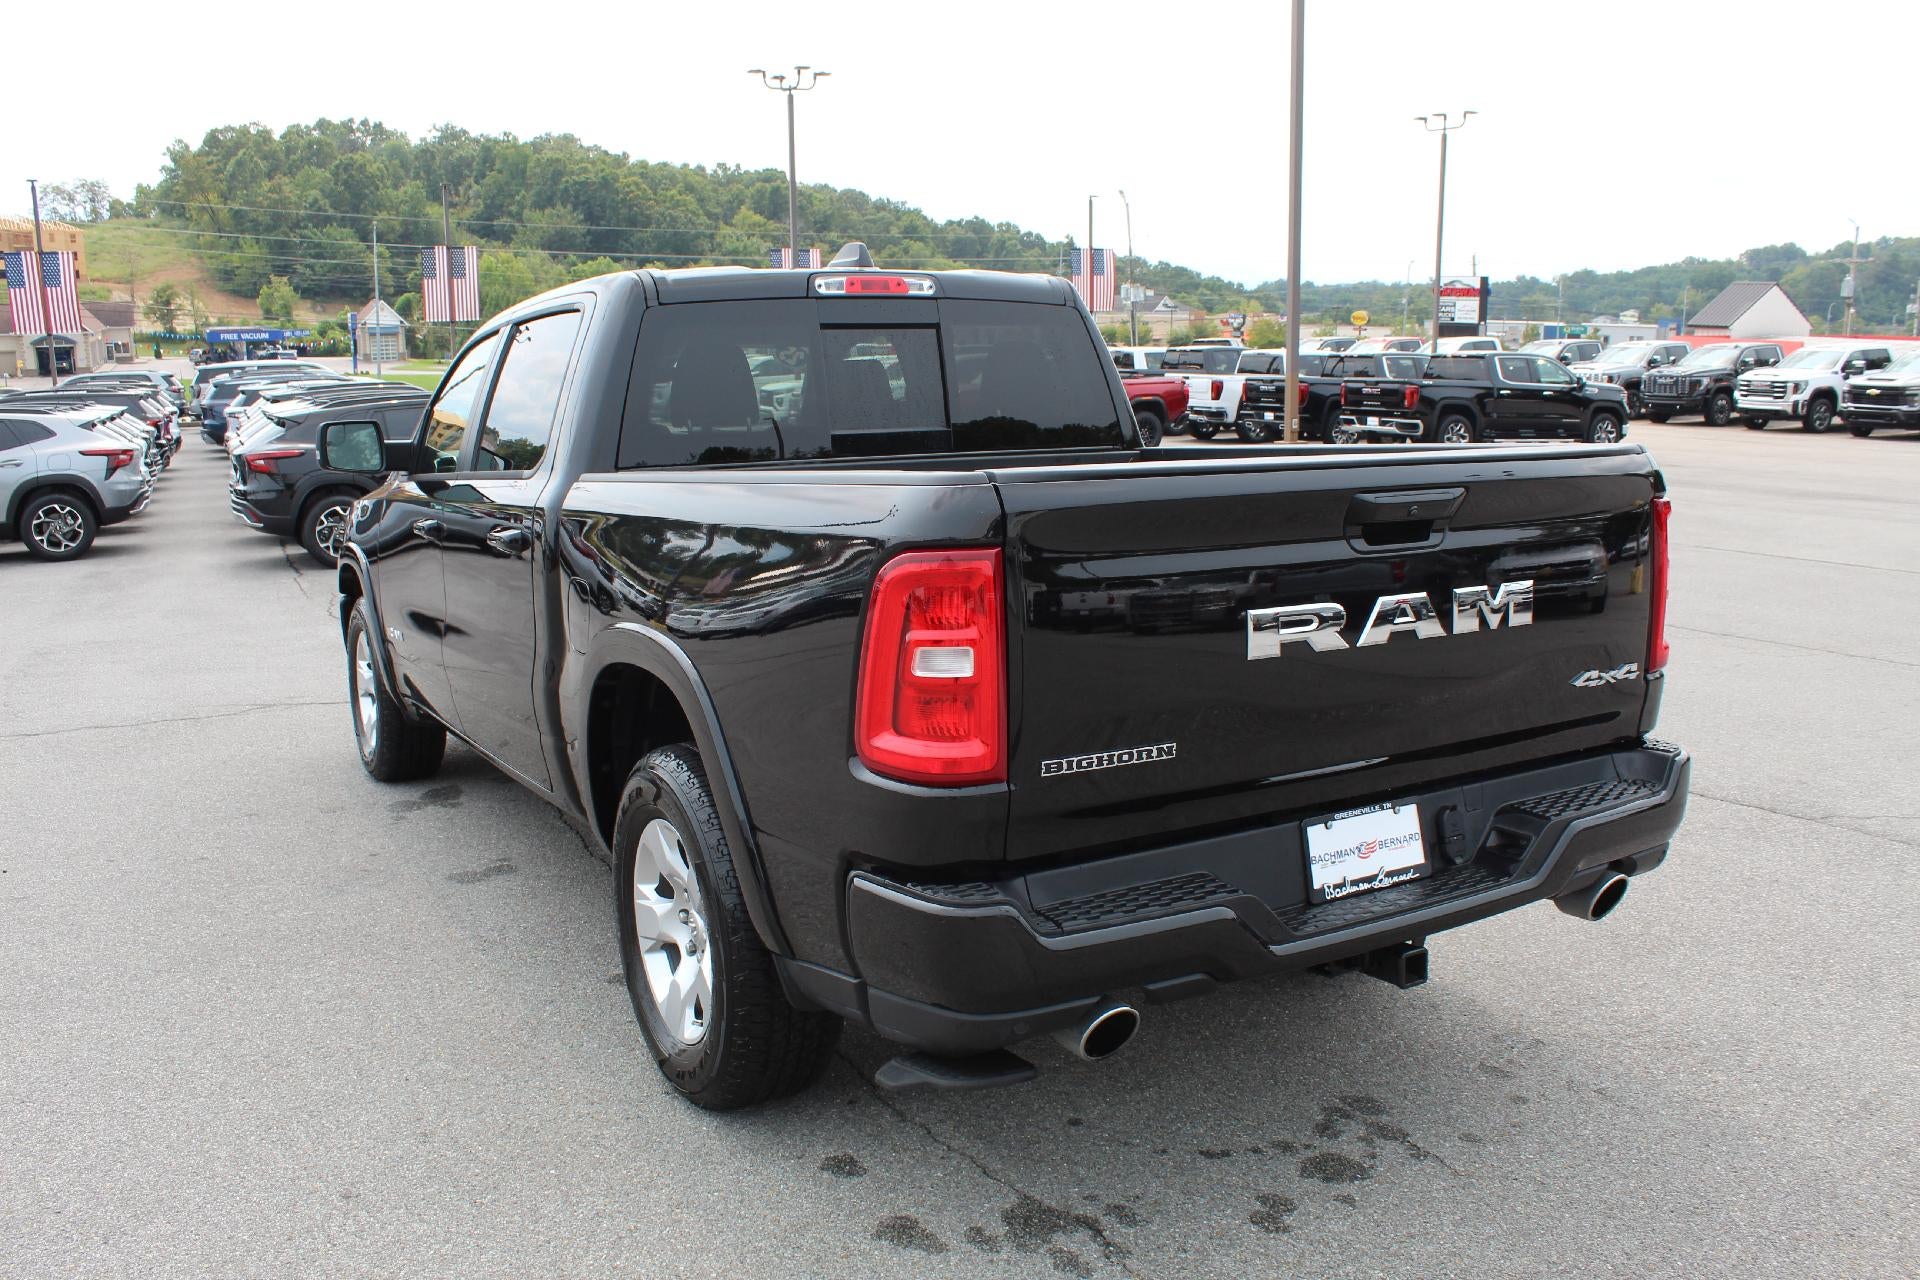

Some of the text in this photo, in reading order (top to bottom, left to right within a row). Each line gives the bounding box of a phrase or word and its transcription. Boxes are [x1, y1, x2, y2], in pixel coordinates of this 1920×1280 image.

[220, 332, 269, 341] FREE VACUUM
[1247, 580, 1534, 661] RAM
[1041, 742, 1177, 777] BIGHORN
[1334, 802, 1392, 820] GREENEVILLE, TN
[1310, 846, 1356, 865] BACHMAN
[1378, 832, 1421, 850] BERNARD
[1323, 876, 1372, 900] Bachman
